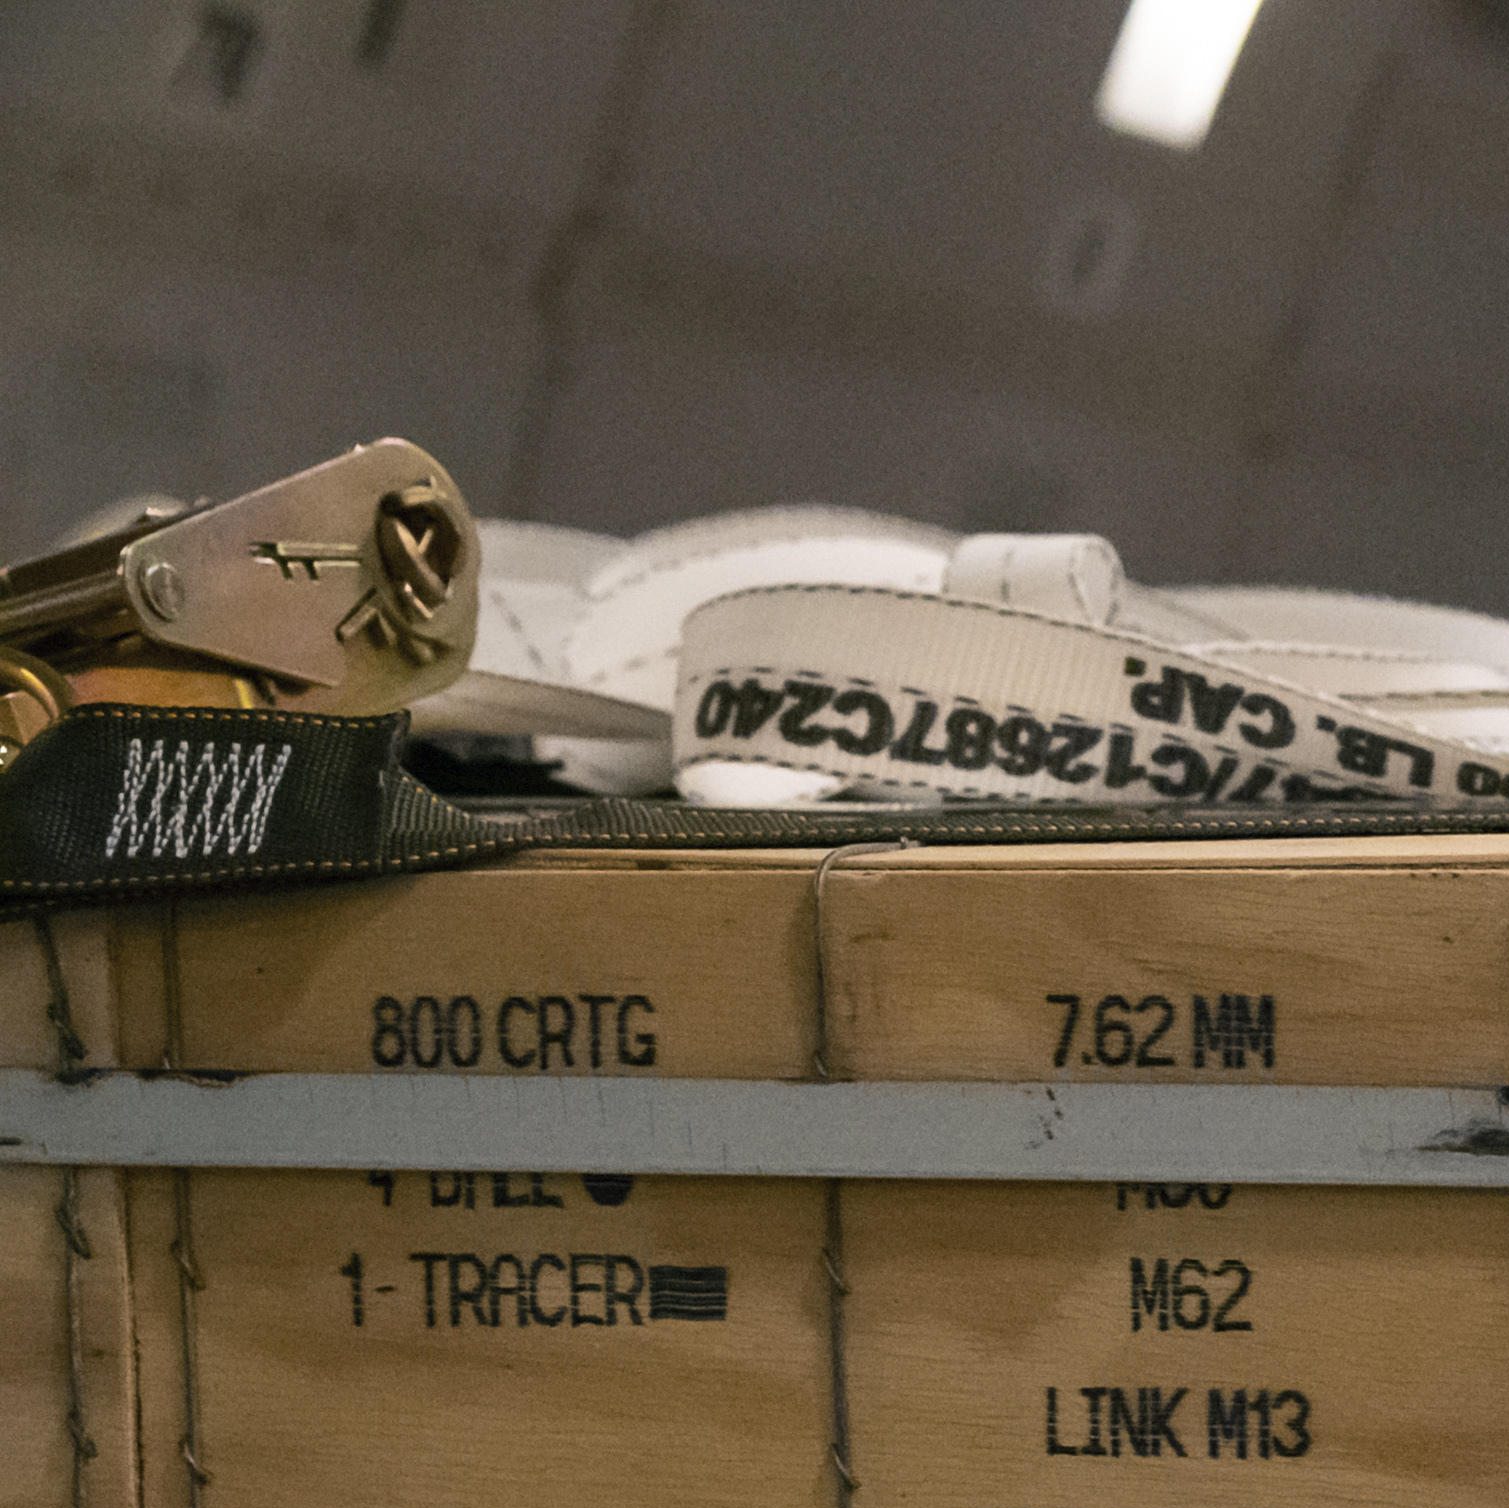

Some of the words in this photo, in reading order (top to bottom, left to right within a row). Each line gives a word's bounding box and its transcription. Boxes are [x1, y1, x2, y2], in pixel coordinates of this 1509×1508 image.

[1122, 656, 1296, 749] CAP.
[1317, 716, 1435, 790] LB.
[371, 996, 482, 1069] 800
[496, 993, 656, 1071] CRTG
[1046, 993, 1176, 1068] 7.62
[1193, 994, 1275, 1069] MM
[407, 1251, 645, 1329] TRACER
[1130, 1257, 1253, 1333] M62
[1046, 1386, 1188, 1458] LINK
[1207, 1389, 1312, 1459] M13
